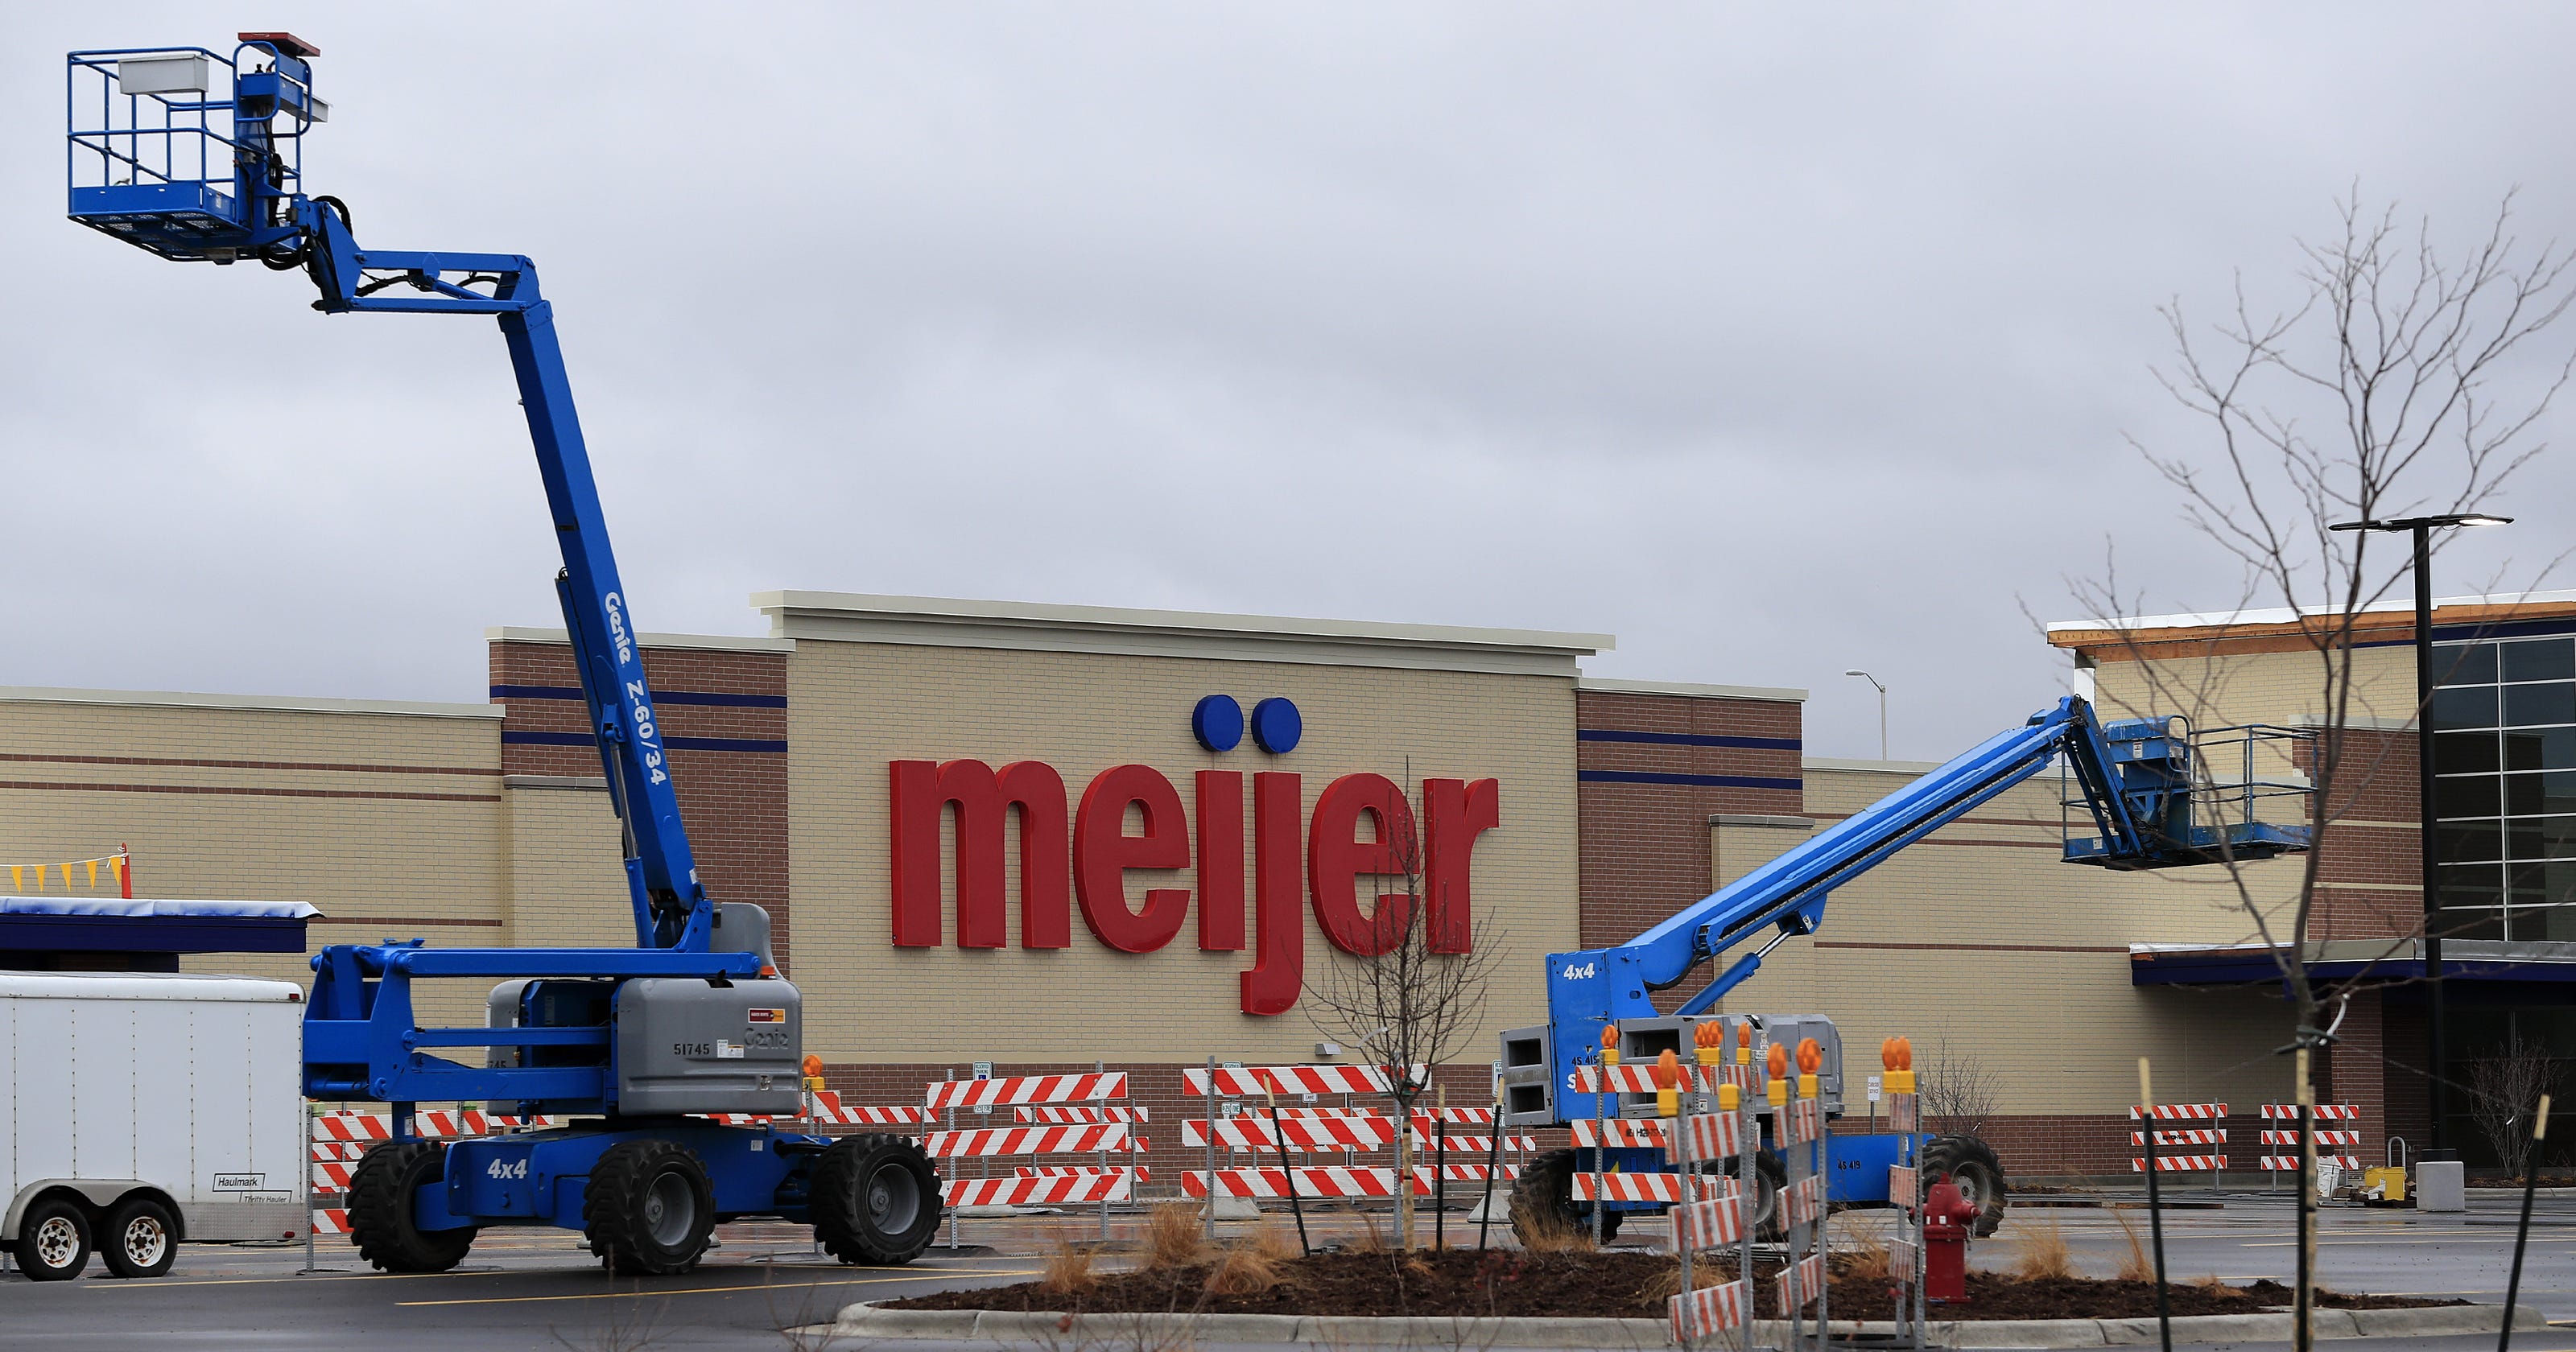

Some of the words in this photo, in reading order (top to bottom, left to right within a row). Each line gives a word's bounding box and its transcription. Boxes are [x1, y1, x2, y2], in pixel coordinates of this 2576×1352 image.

[605, 592, 631, 666] Genie
[626, 679, 667, 785] Z-60/34
[890, 695, 1499, 1016] meijer
[1563, 962, 1595, 980] 4x4
[674, 1043, 710, 1055] 51745
[744, 1028, 788, 1049] Genie
[487, 1158, 527, 1179] 4x4
[218, 1177, 258, 1186] Haulmark
